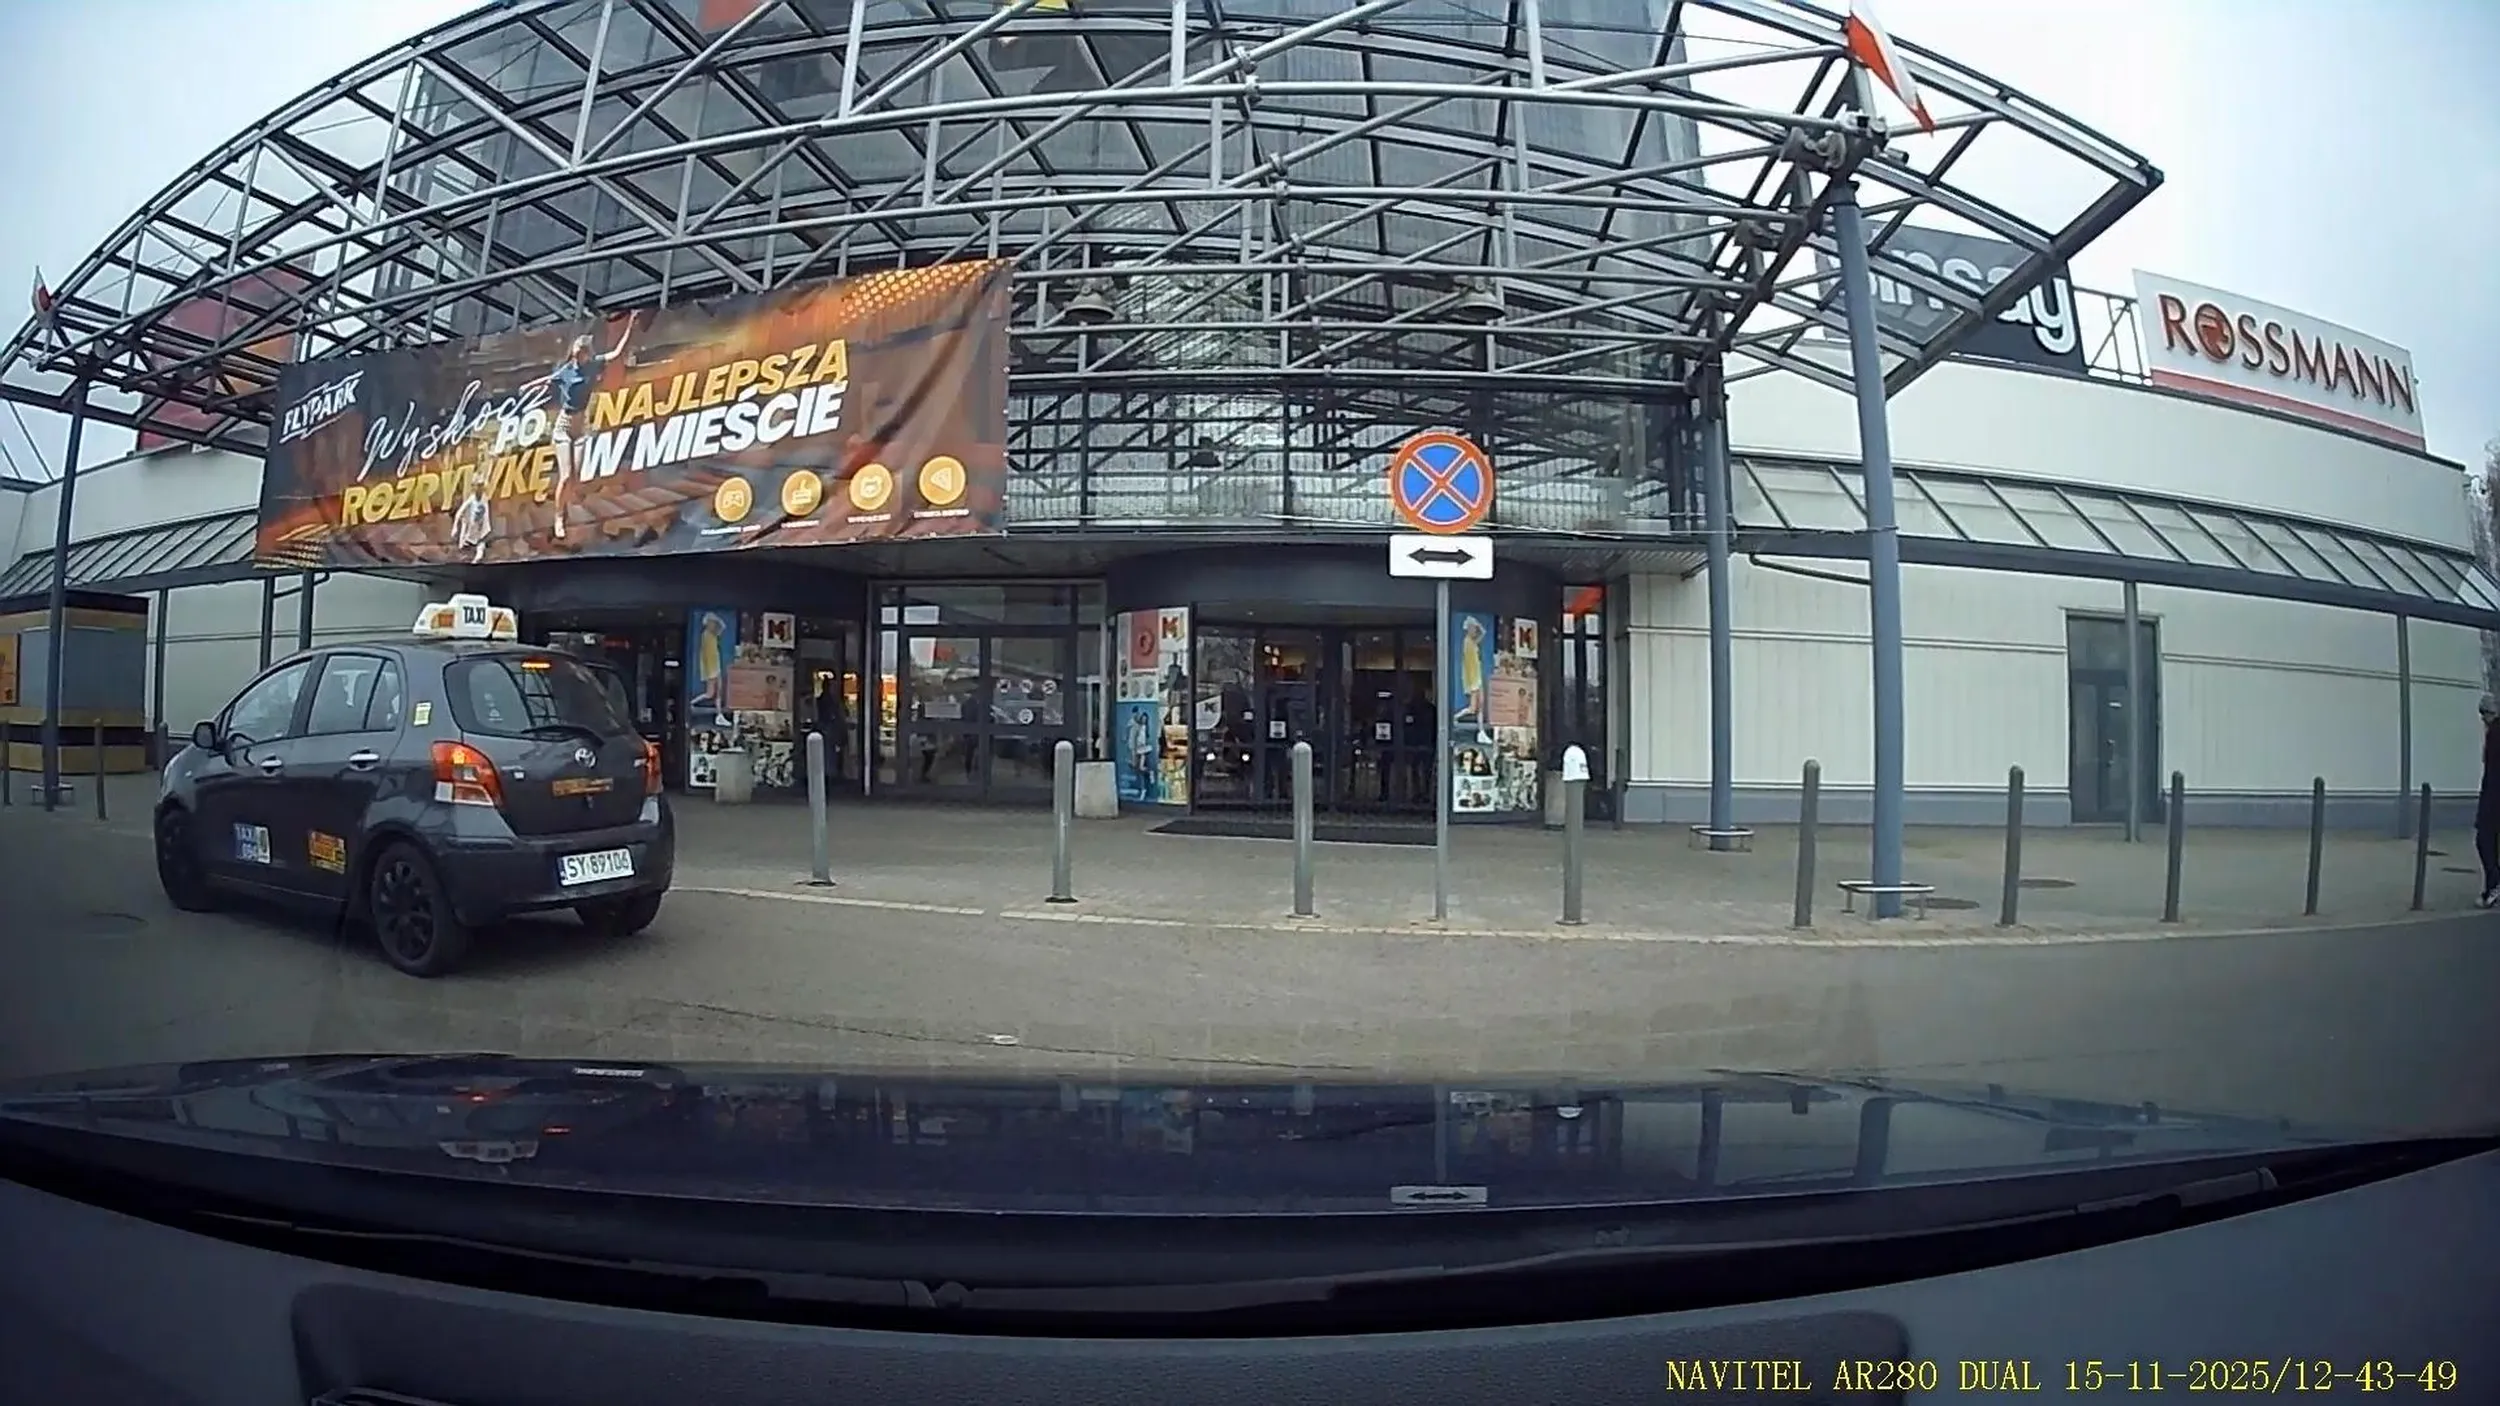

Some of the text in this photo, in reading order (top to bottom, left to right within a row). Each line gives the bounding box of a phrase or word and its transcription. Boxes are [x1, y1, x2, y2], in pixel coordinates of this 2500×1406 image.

[592, 339, 848, 428] NAJLEPSZĄ
[2158, 294, 2414, 414] ROSSMANN
[283, 378, 361, 436] FLYPARK
[356, 380, 551, 481] Wyskocz
[580, 427, 633, 482] W
[631, 380, 848, 471] MIEŚCIE
[463, 606, 486, 624] TAXI
